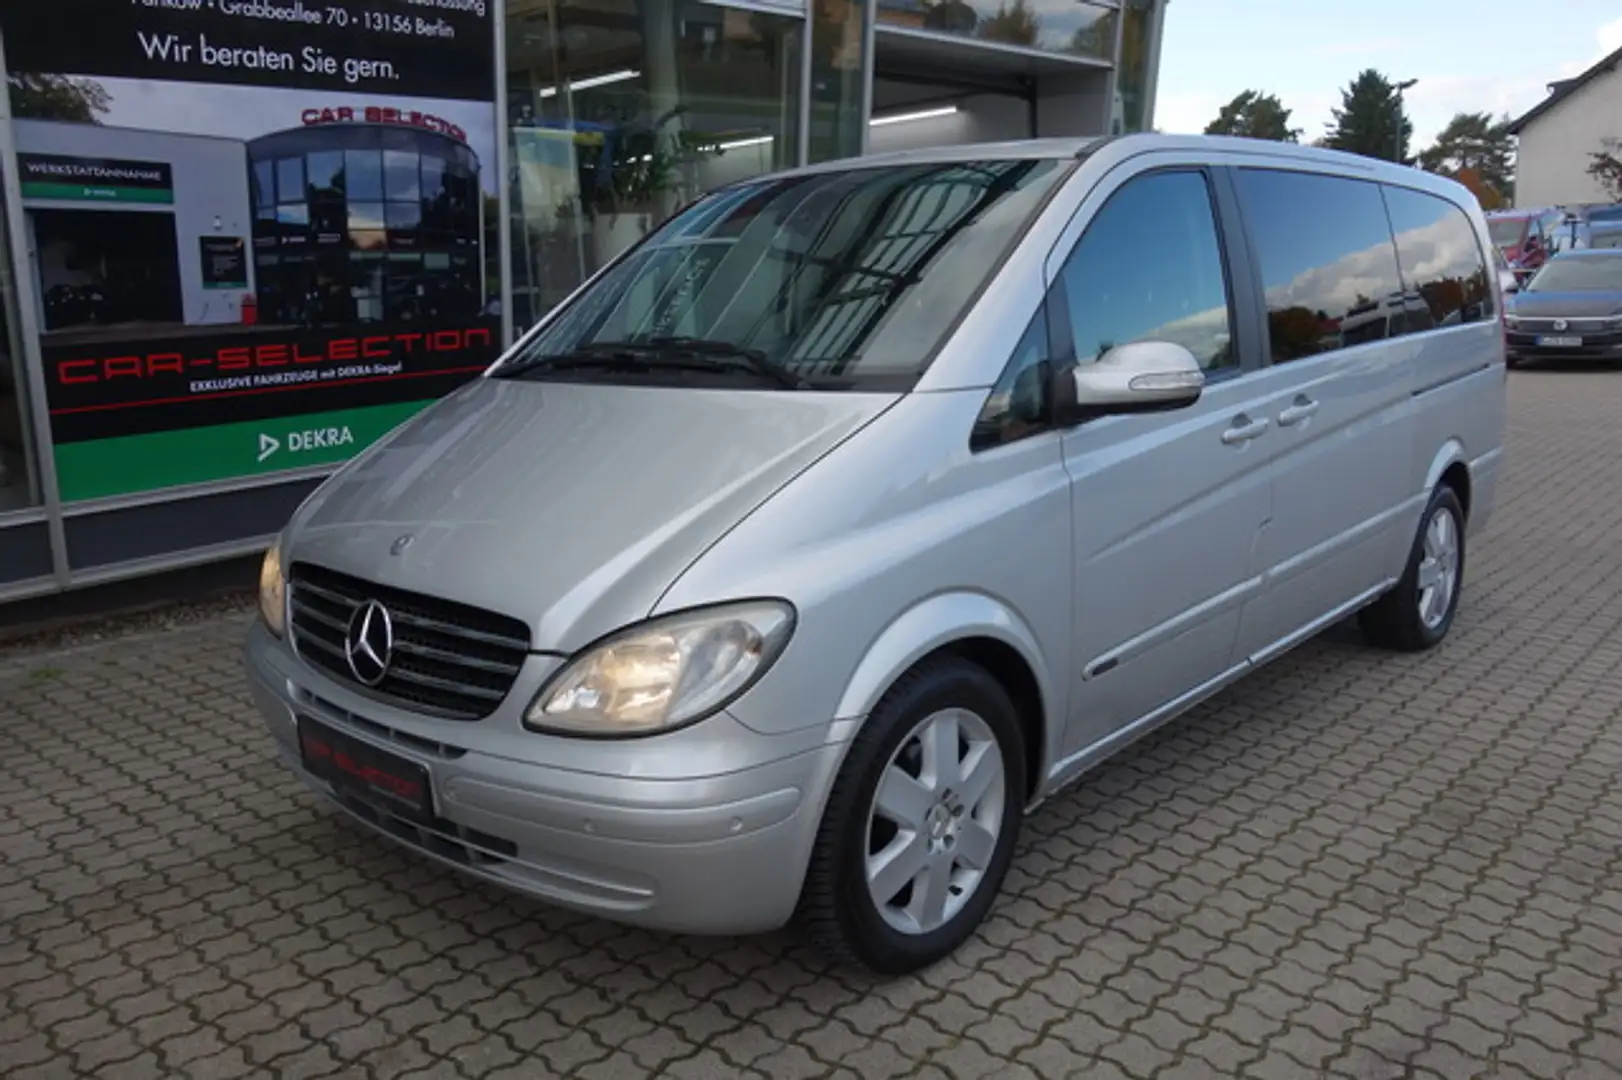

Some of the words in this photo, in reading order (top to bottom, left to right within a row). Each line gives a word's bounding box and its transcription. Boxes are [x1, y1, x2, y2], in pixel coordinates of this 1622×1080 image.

[325, 7, 348, 27] 70
[364, 12, 412, 34] 13156
[415, 18, 456, 39] Berlin
[137, 31, 192, 63] Wir
[200, 33, 295, 71] beraten
[302, 46, 337, 74] Sie
[344, 57, 400, 83] gern.
[301, 106, 354, 126] CAR
[58, 328, 490, 384] CAR-SELECTION
[189, 375, 252, 393] EXKLUSIVE
[253, 368, 318, 388] FAHRZEUGE
[320, 367, 337, 380] mit
[287, 425, 355, 452] DEKRA
